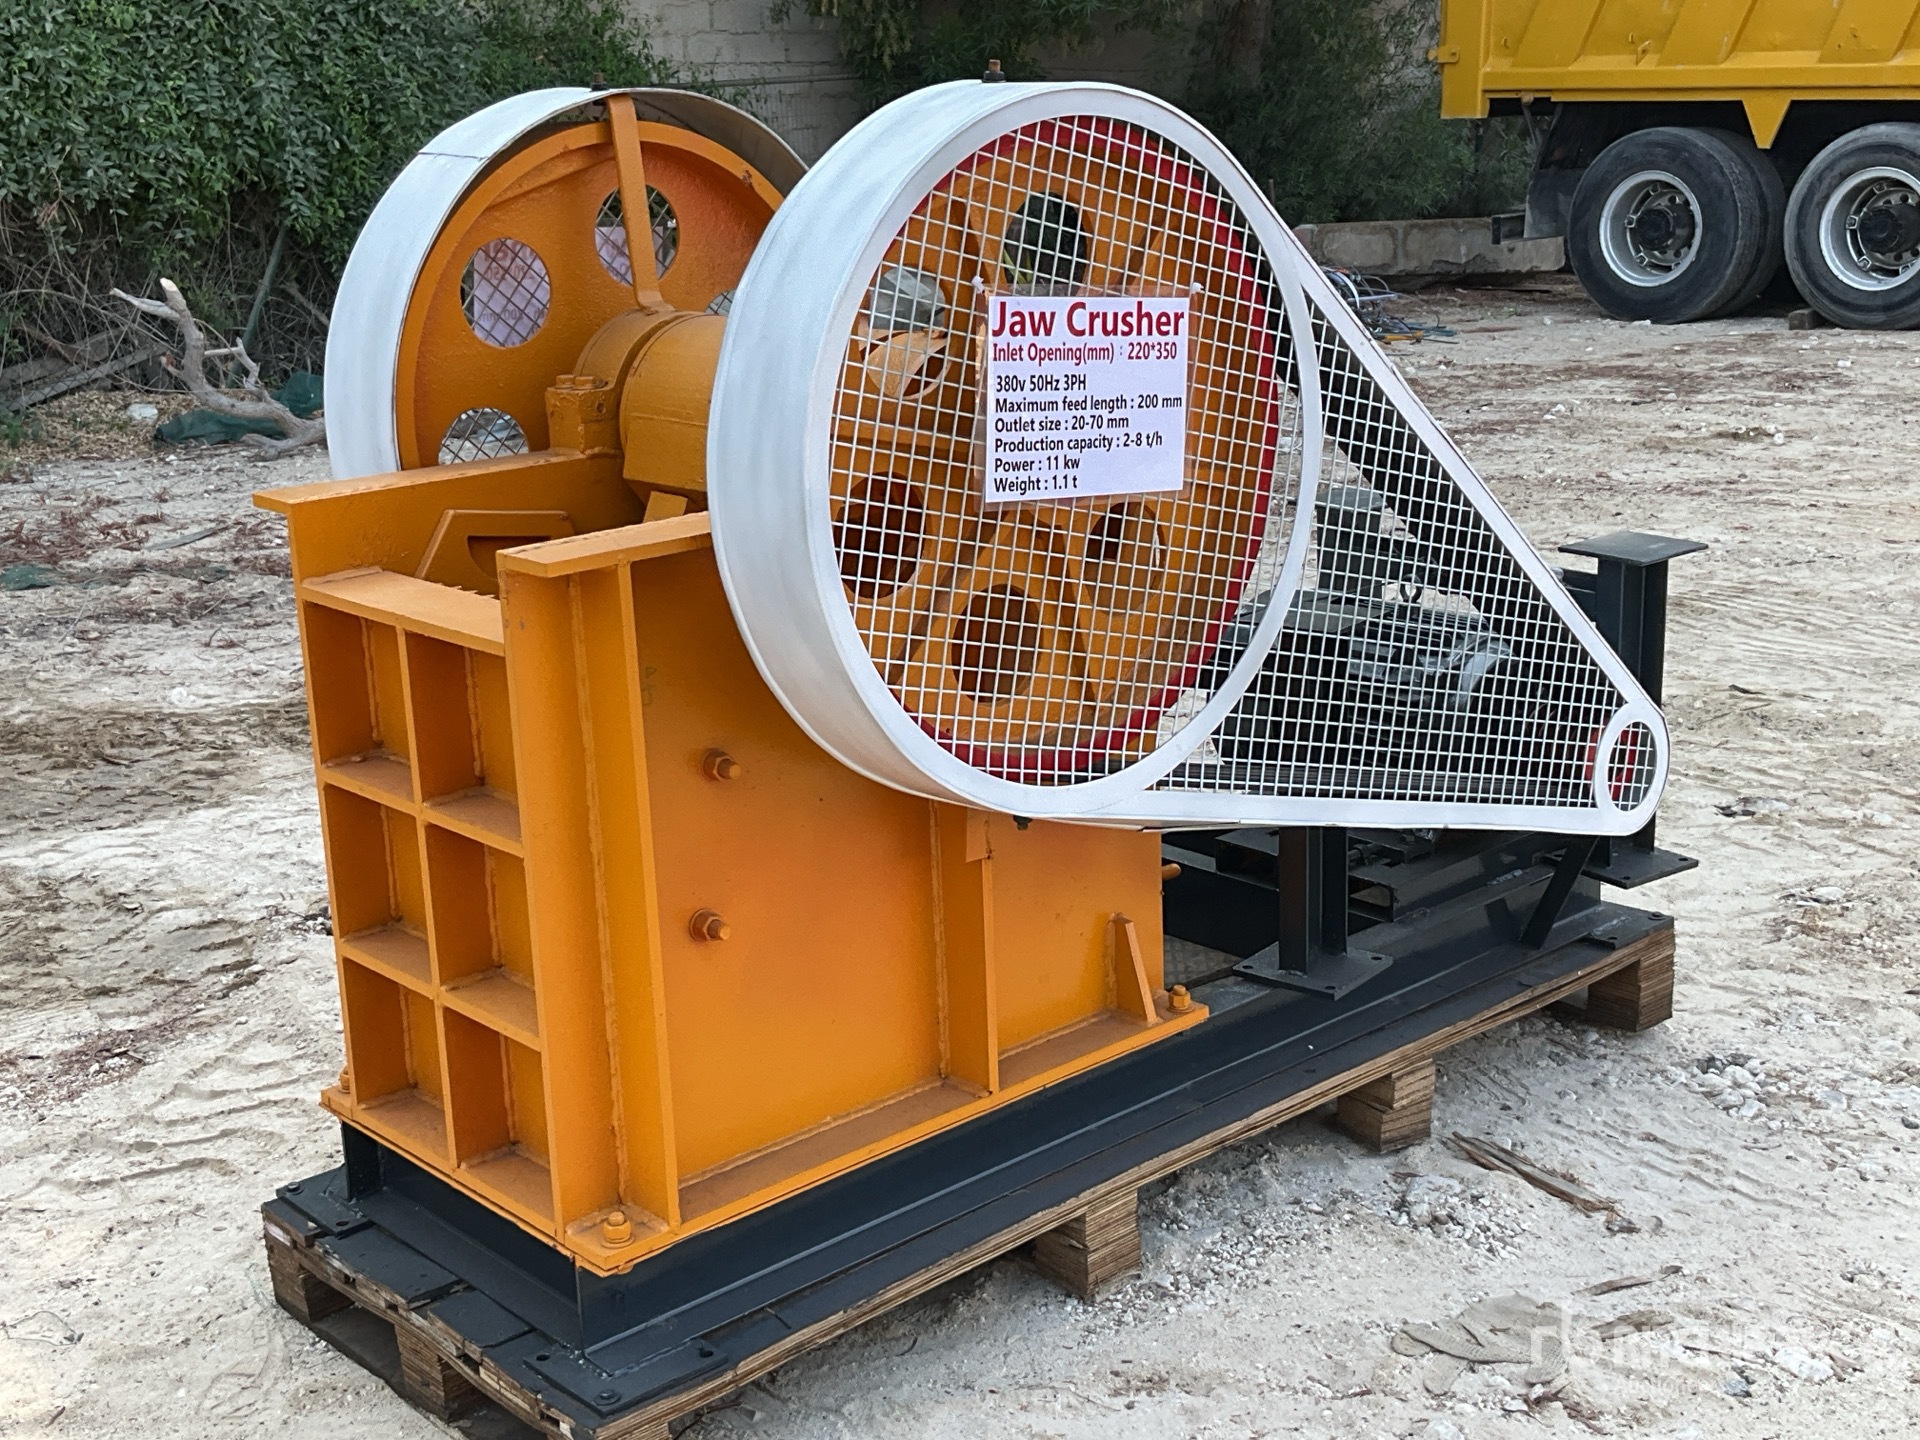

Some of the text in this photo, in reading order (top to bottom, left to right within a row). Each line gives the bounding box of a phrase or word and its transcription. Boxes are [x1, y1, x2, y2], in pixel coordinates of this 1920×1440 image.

[992, 301, 1184, 337] Jaw Crusher
[993, 342, 1023, 361] Inlet
[1028, 342, 1114, 367] Opening(mm)
[996, 374, 1086, 392] 380v 50Hz 3PH
[996, 397, 1058, 413] Maximum
[1062, 395, 1087, 411] feed
[1091, 394, 1127, 414] length
[1138, 394, 1158, 408] 200
[1162, 397, 1182, 408] mm
[995, 417, 1035, 432] Outlet
[1039, 416, 1061, 431] size
[1072, 415, 1103, 430] 20-70
[1107, 417, 1128, 428] mm
[995, 436, 1063, 452] Production
[1068, 435, 1113, 453] capacity
[1123, 432, 1142, 447] 2-8
[1146, 431, 1162, 448] t/h
[995, 458, 1035, 472] Power
[1047, 455, 1058, 470] 11
[1064, 454, 1080, 469] kw
[994, 476, 1041, 495] Weight
[1053, 474, 1067, 489] 1.1
[1072, 475, 1077, 488] t
